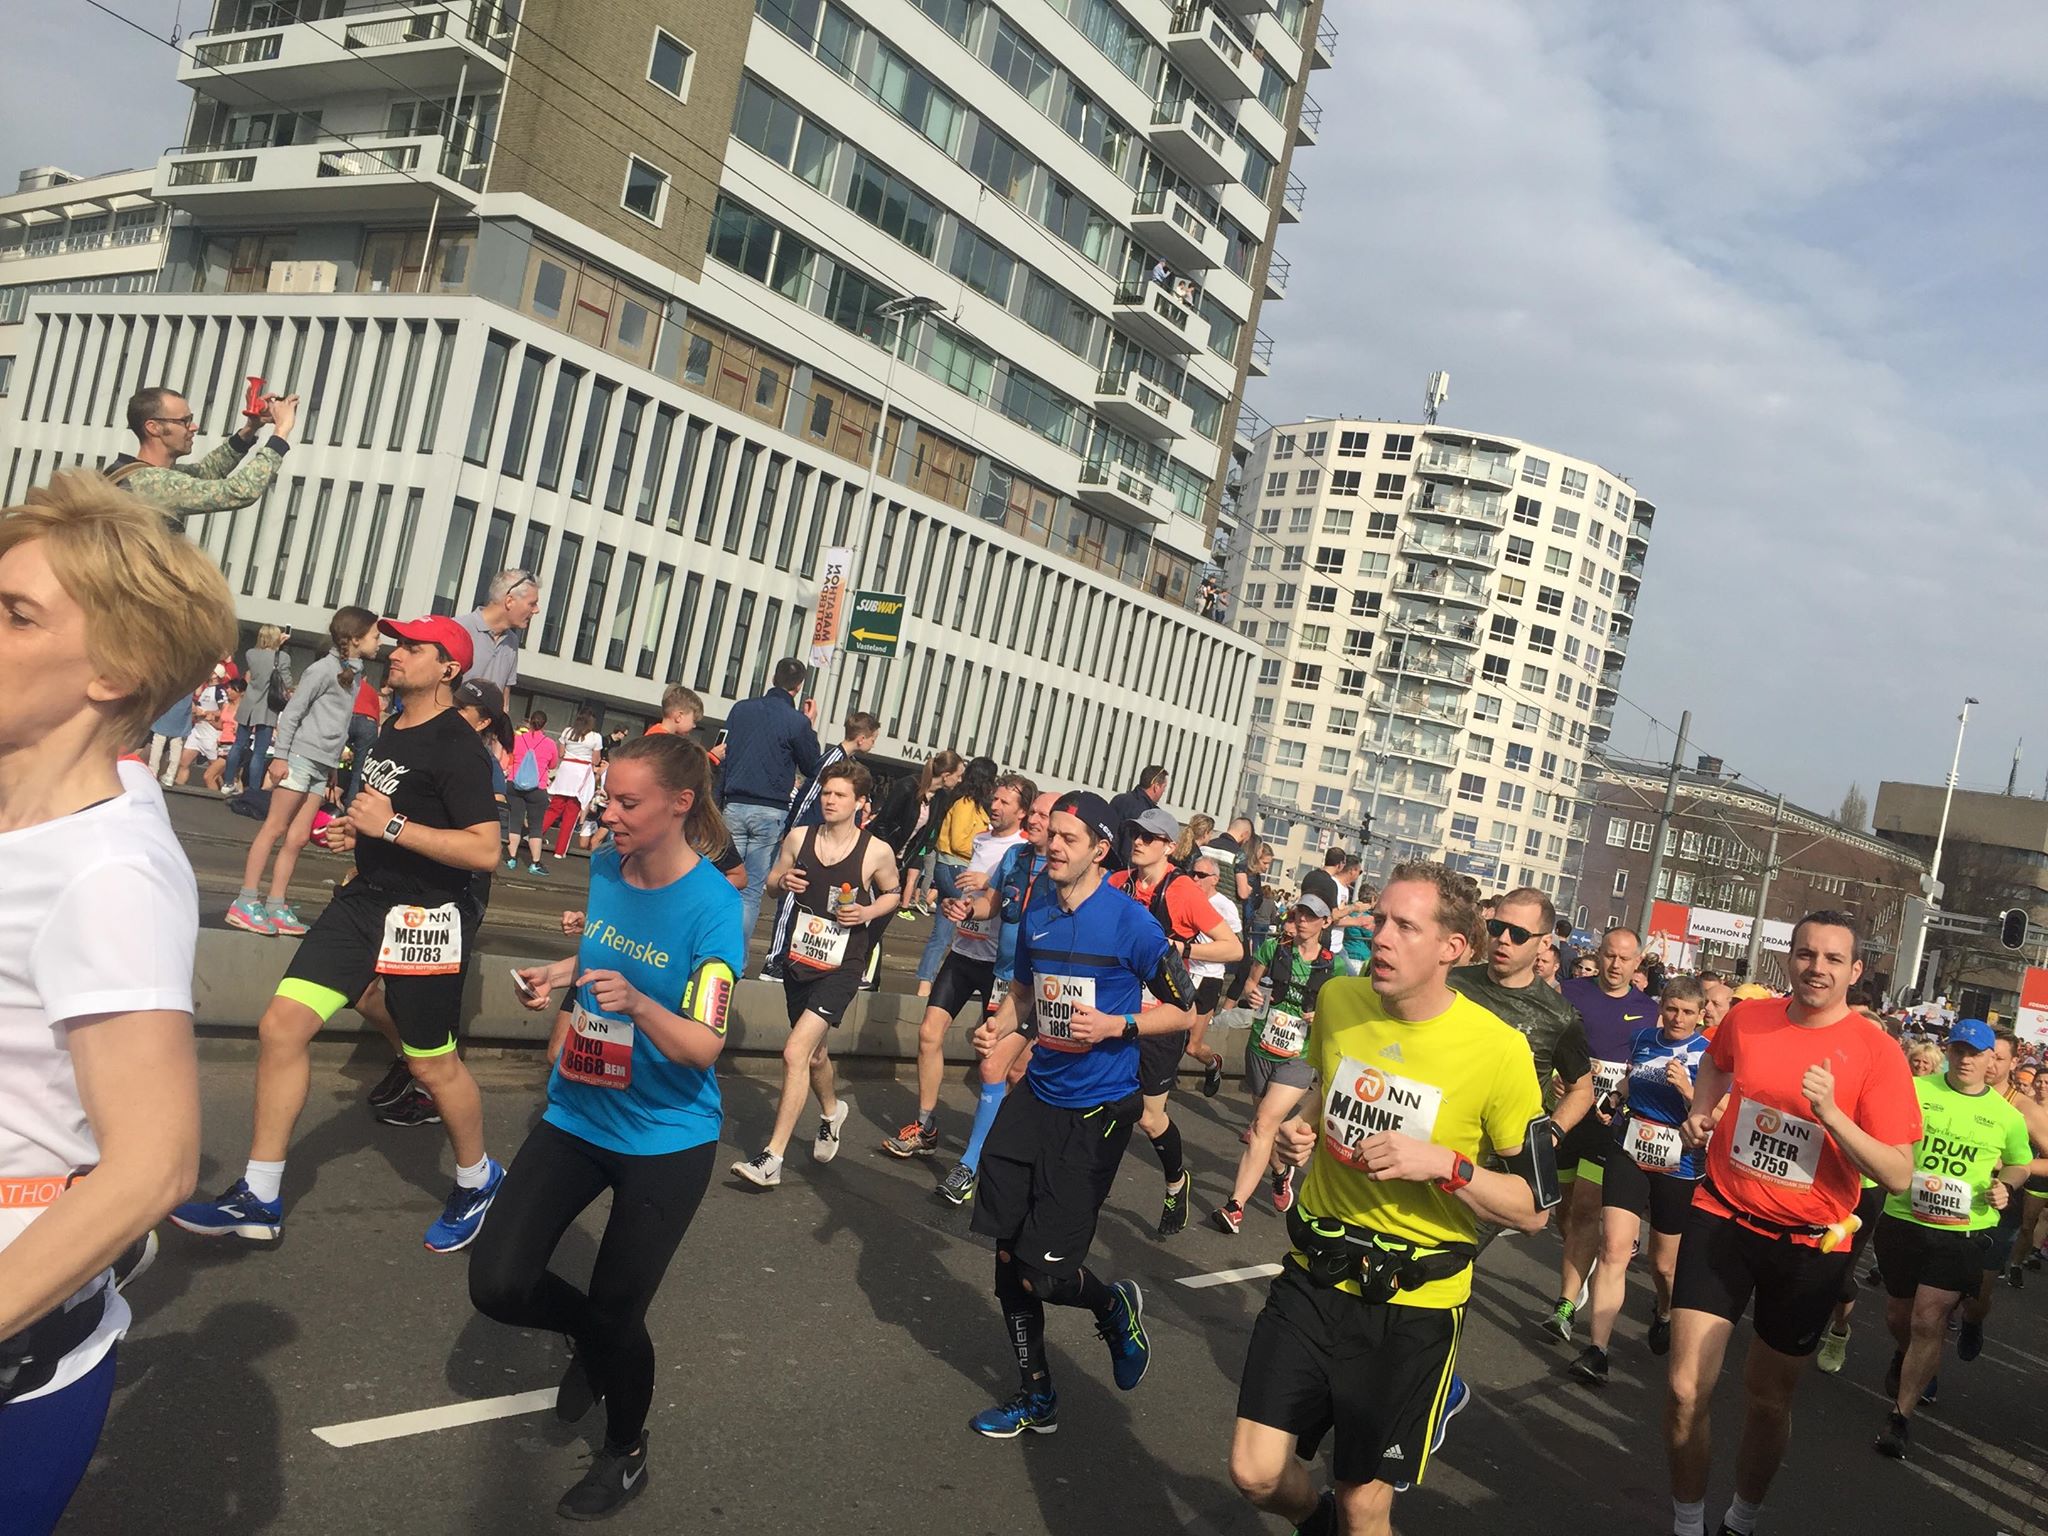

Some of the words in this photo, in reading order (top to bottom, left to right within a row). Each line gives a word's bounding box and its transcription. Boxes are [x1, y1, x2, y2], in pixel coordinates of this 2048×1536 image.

[856, 599, 903, 614] SUBWAY
[856, 642, 888, 653] Vasteland
[429, 911, 451, 923] NN
[394, 928, 450, 946] MELVIN
[802, 932, 837, 952] DANNY
[1692, 923, 1740, 938] MARATHON
[1742, 933, 1791, 947] ROERDAM
[400, 946, 442, 963] 10783
[600, 925, 669, 968] Renske
[1062, 984, 1083, 997] NN
[588, 1019, 609, 1034] NN
[1270, 1024, 1296, 1041] PAULA
[1604, 1066, 1618, 1075] NN
[1387, 1086, 1422, 1110] NN
[1329, 1090, 1404, 1131] MANNE
[1657, 1132, 1674, 1142] NN
[1782, 1122, 1810, 1141] NN
[1635, 1139, 1670, 1157] KERRY
[1749, 1130, 1799, 1162] PETER
[1931, 1137, 1978, 1163] RUN
[1751, 1152, 1789, 1177] 3759
[1944, 1182, 1963, 1194] NN
[1920, 1190, 1961, 1209] MICHEL
